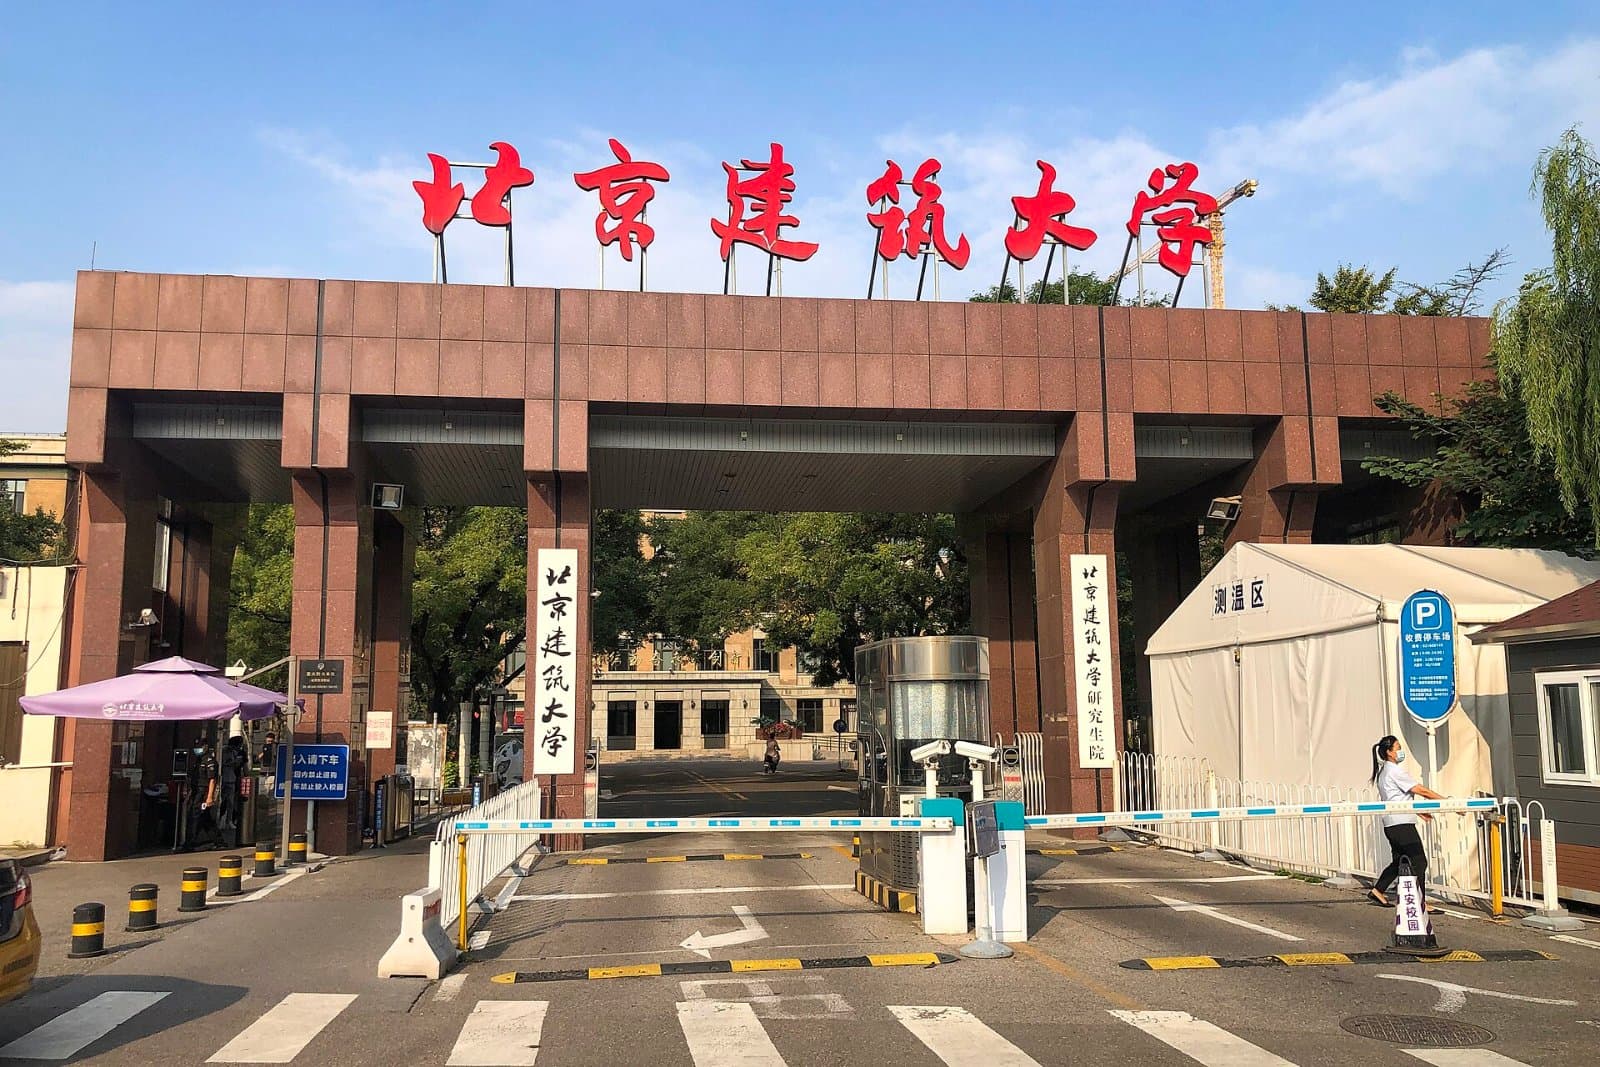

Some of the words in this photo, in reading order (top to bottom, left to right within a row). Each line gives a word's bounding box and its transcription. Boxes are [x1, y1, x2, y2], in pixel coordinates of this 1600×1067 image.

[412, 138, 1218, 277] 北京建筑大学
[1214, 580, 1265, 615] 测温区
[1416, 602, 1437, 626] P
[541, 565, 573, 758] 北京建筑大学
[1083, 565, 1106, 761] 北京建筑大学研究生院
[1404, 631, 1452, 643] 收费停车场
[1402, 880, 1420, 932] 平安校园
